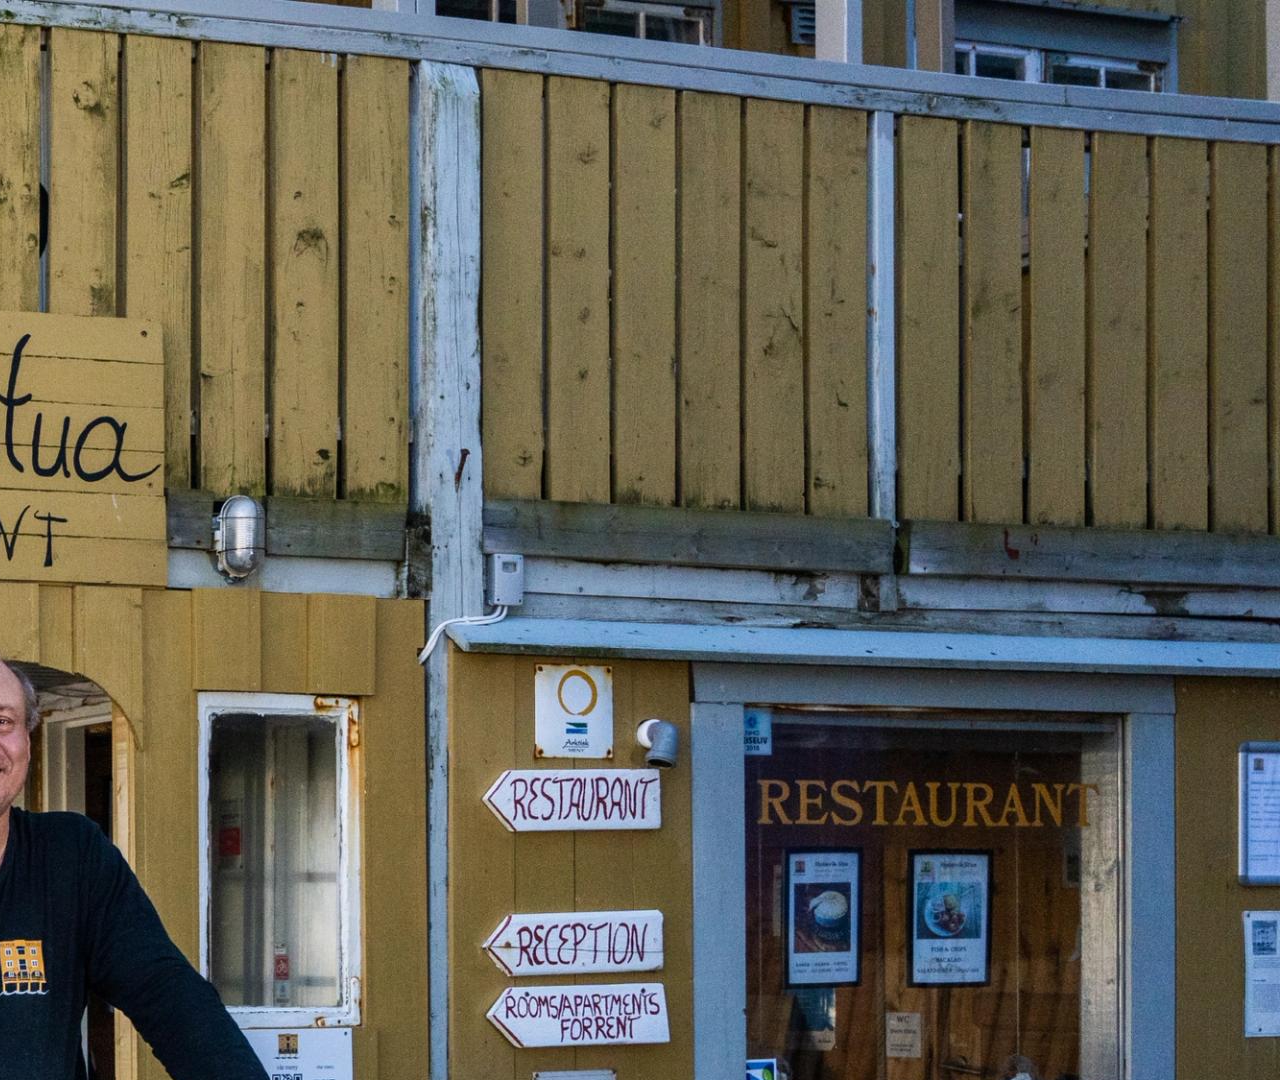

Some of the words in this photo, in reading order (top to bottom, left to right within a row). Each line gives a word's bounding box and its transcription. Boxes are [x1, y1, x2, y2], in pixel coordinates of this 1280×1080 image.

[510, 776, 658, 822] RESTAURANT
[756, 779, 1100, 828] RESTAURANT
[516, 922, 648, 967] RECEPTION
[505, 992, 660, 1020] ROOMS/APARTMENTS
